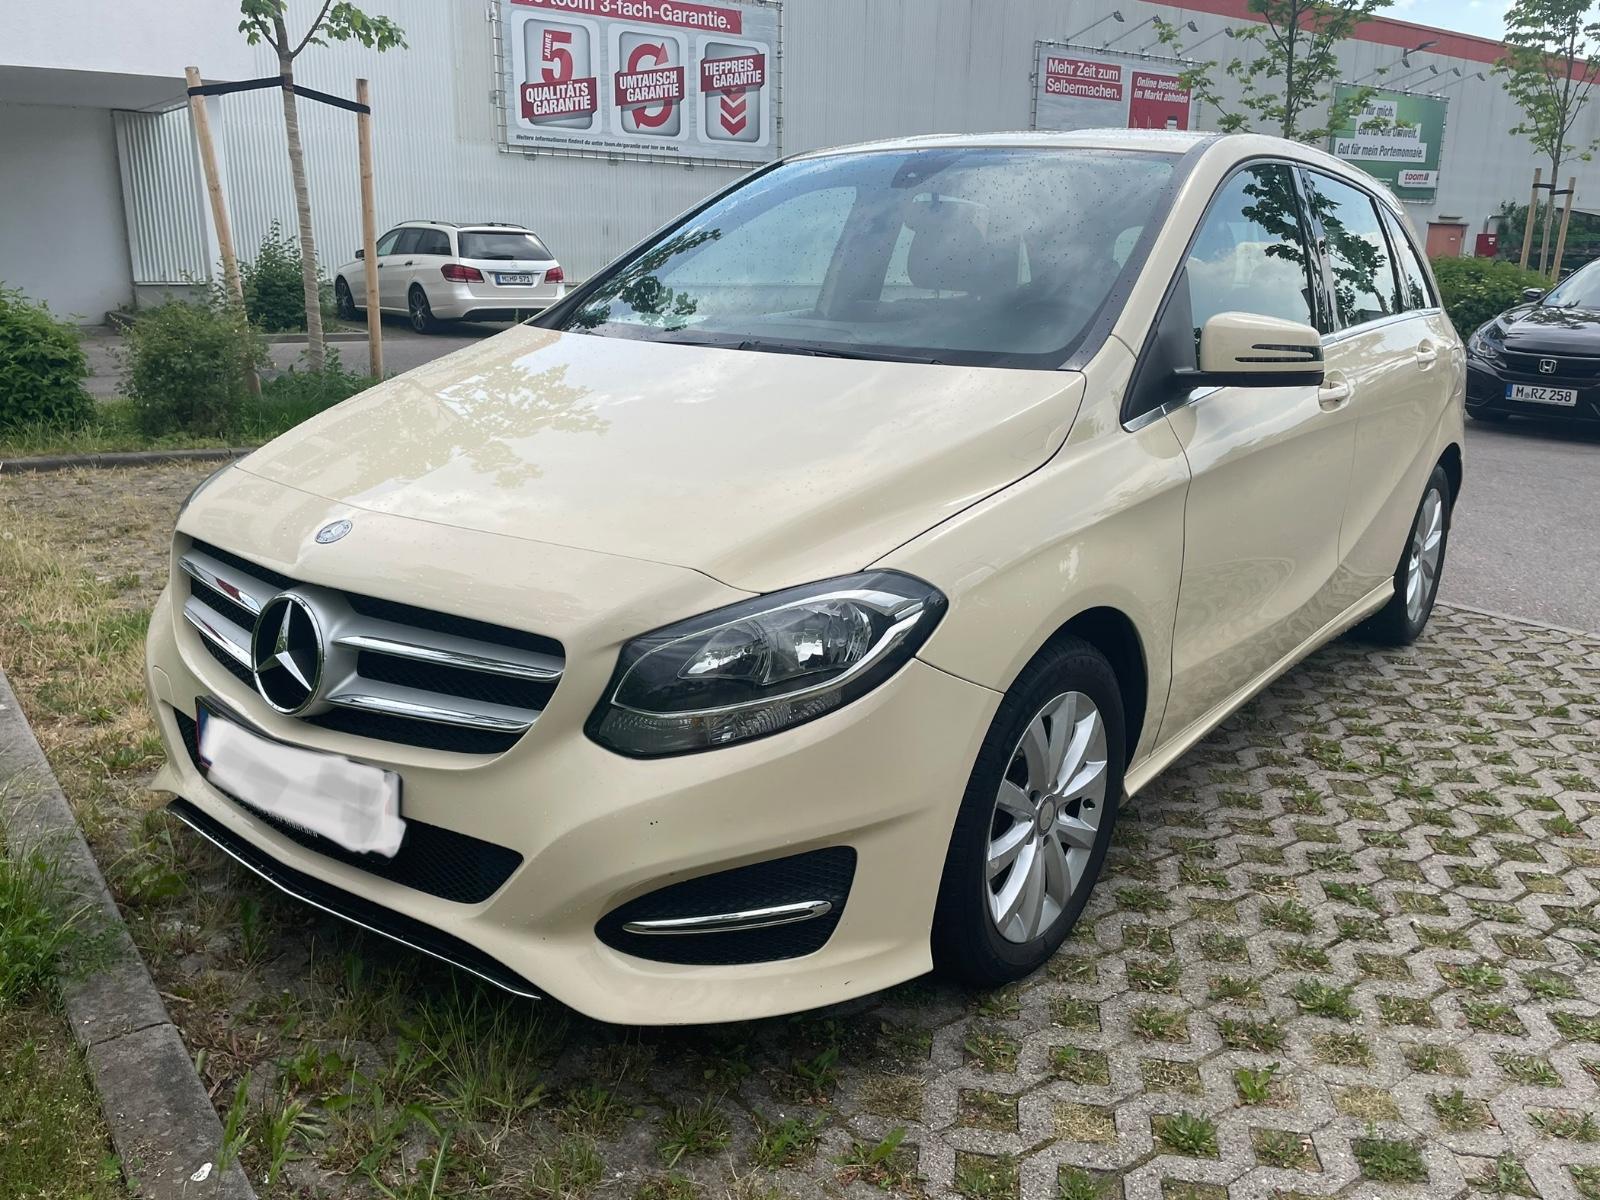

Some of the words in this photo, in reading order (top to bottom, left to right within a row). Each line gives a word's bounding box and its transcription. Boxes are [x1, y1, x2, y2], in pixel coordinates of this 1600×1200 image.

[599, 0, 731, 29] 3-fach-Garantie.
[544, 32, 553, 59] JAHRE
[541, 29, 574, 83] 5
[704, 58, 754, 76] TIEFPREIS
[1048, 59, 1075, 75] Mehr
[1077, 62, 1096, 77] Zeit
[1098, 68, 1119, 80] zum
[619, 70, 678, 90] UMTAUSCH
[713, 70, 762, 88] GARANTIE
[1047, 78, 1120, 99] Selbermachen.
[1136, 76, 1158, 88] Online
[526, 81, 589, 103] QUALITÄTS
[626, 83, 679, 102] GARANTIE
[1134, 88, 1143, 99] im
[1144, 90, 1164, 101] Markt
[1163, 92, 1189, 103] abholen
[533, 95, 591, 115] GARANTIE
[1377, 105, 1394, 117] mich.
[1338, 142, 1349, 155] Gut
[1351, 143, 1361, 155] für
[1362, 145, 1378, 156] mein
[1379, 145, 1423, 158] Portemonnaie.
[1531, 388, 1547, 400] RZ
[1549, 390, 1572, 402] 258
